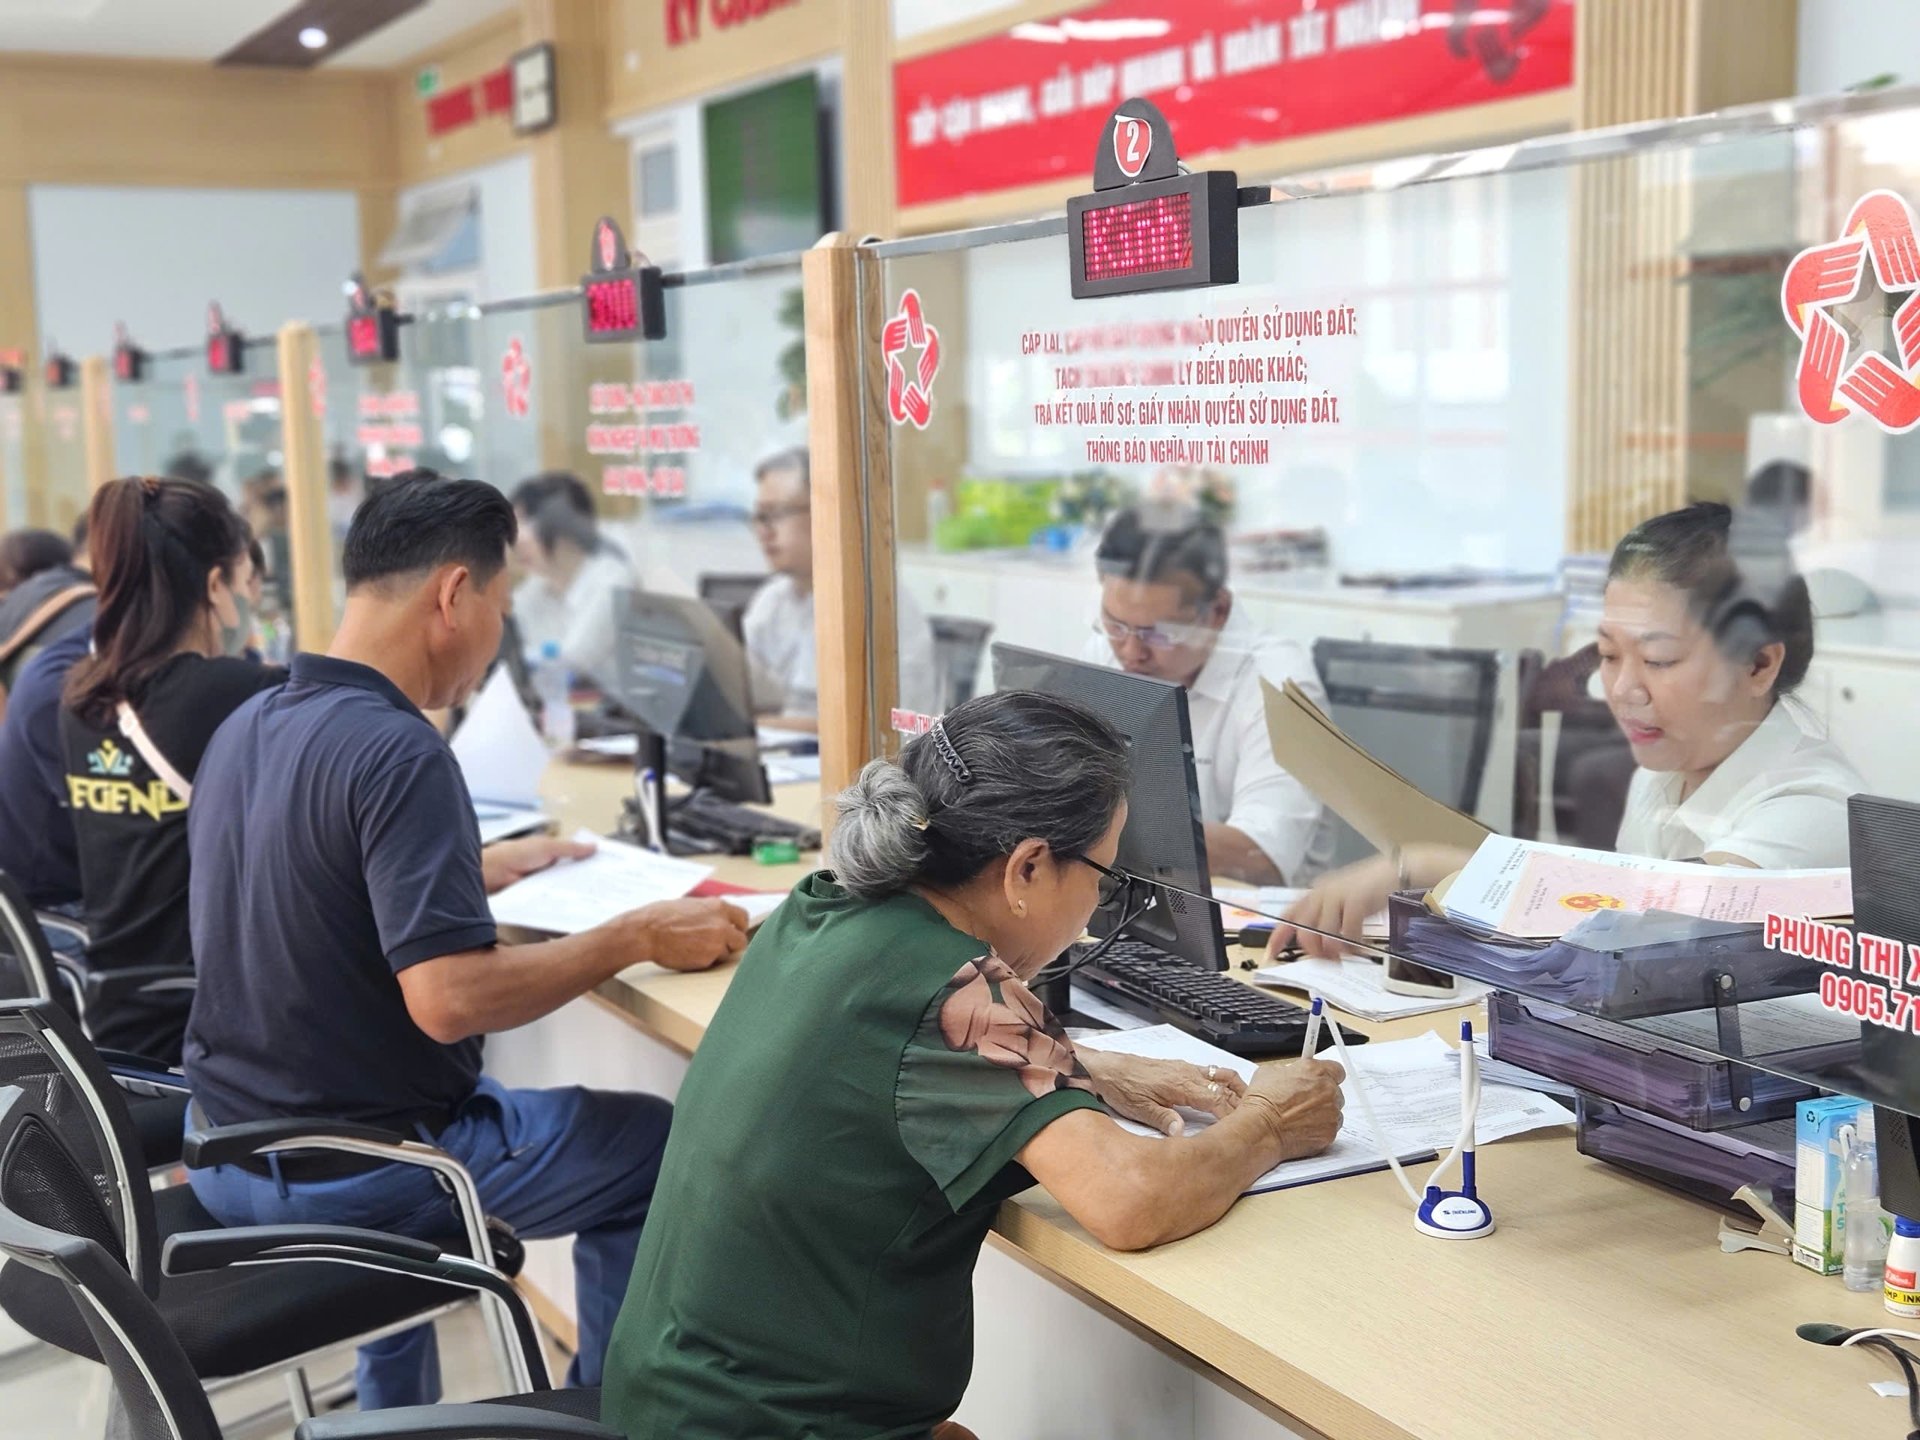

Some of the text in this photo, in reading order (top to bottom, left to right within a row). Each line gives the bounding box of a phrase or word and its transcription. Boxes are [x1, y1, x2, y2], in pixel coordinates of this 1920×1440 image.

[1127, 120, 1140, 162] 2
[1263, 304, 1283, 341] SỬ
[1285, 310, 1323, 346] DỤNG
[1196, 350, 1225, 385] BIẾN
[1228, 353, 1264, 389] ĐỘNG
[1267, 350, 1308, 384] KHÁC;
[1055, 394, 1073, 425] KẾT
[1076, 393, 1097, 427] QUẢ
[1138, 392, 1164, 425] GIẤY
[1168, 394, 1201, 430] NHẬN
[1249, 390, 1268, 425] SỬ
[1271, 397, 1307, 430] DỤNG
[1086, 434, 1121, 463] THÔNG
[1124, 436, 1146, 463] BÁO
[1206, 434, 1225, 464] TÀI
[1230, 433, 1269, 465] CHÍNH
[1766, 913, 1851, 966] PHÙNG
[1860, 937, 1901, 986] THỊ
